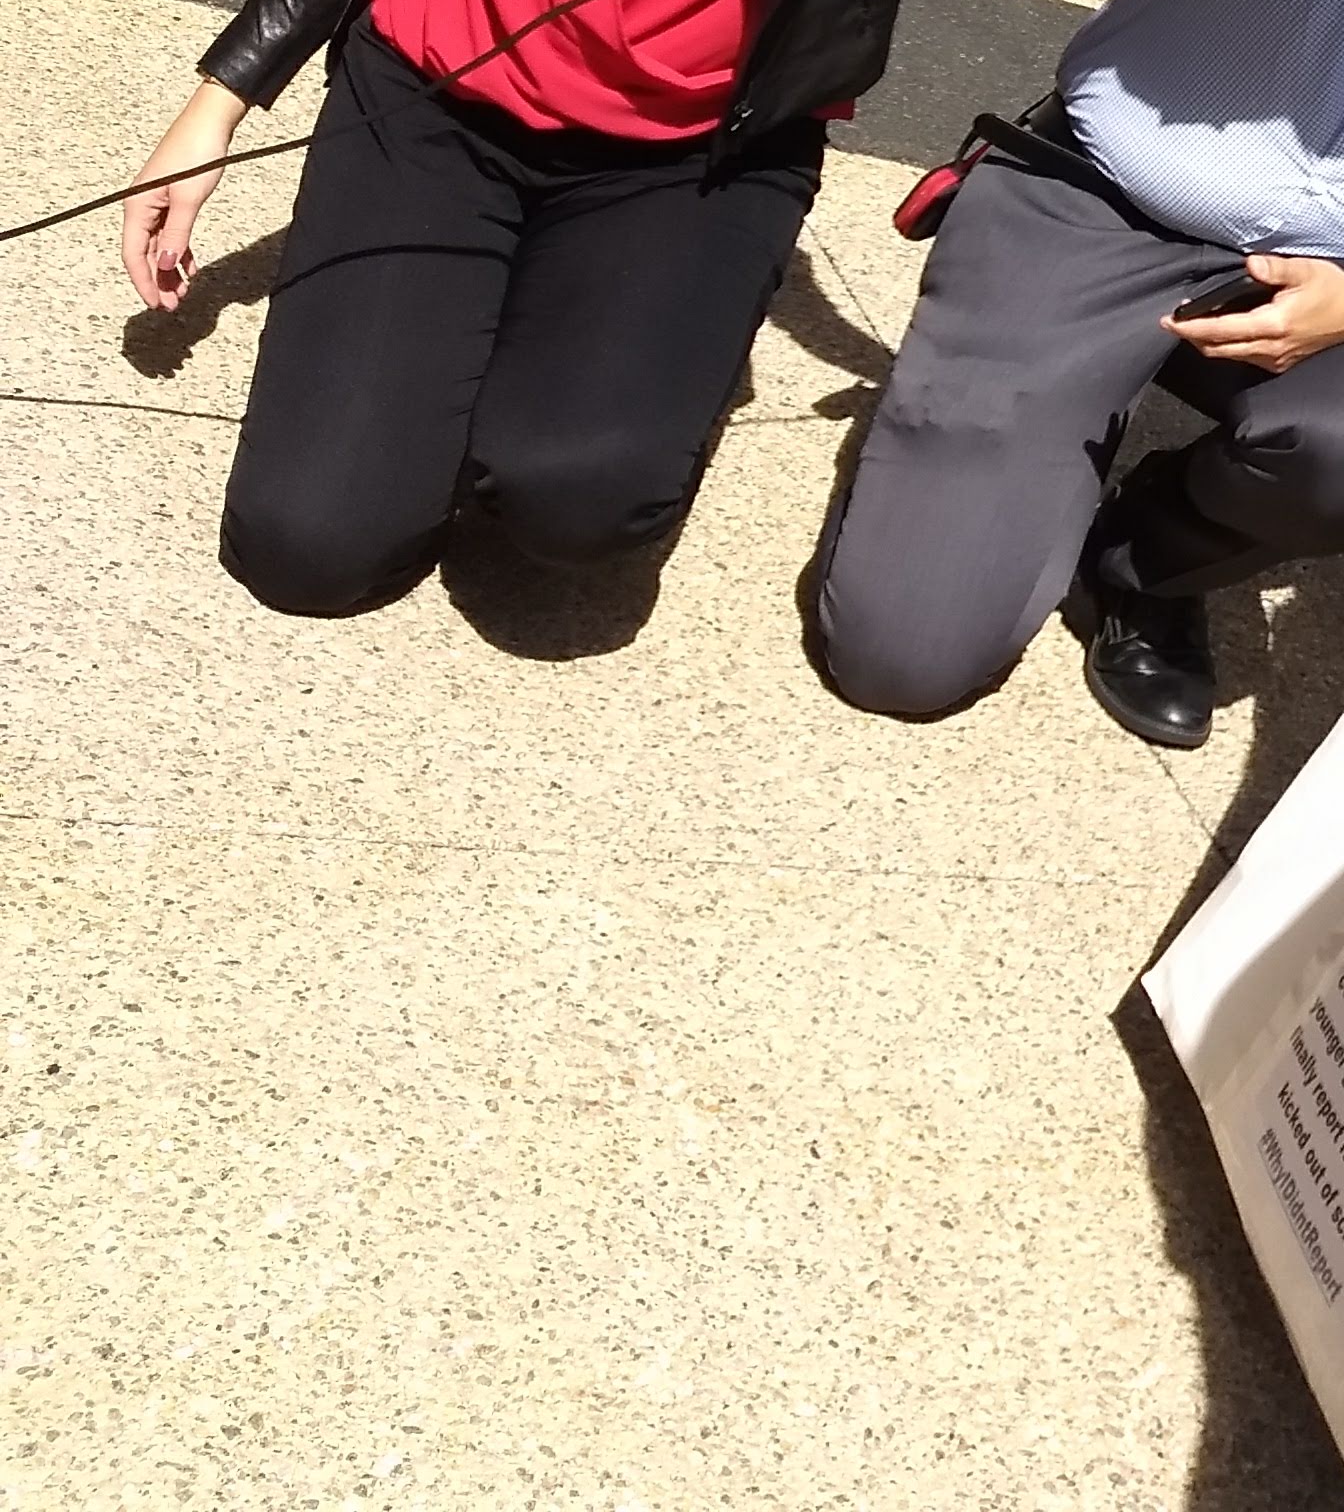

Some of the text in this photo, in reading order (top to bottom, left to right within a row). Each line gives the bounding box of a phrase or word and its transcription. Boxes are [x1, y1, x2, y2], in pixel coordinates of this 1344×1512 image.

[1288, 1023, 1319, 1088] finally
[1276, 1082, 1313, 1152] kicked
[1303, 1148, 1329, 1186] out
[1320, 1182, 1341, 1208] of
[1259, 1127, 1344, 1304] #WhyIDidntReport
